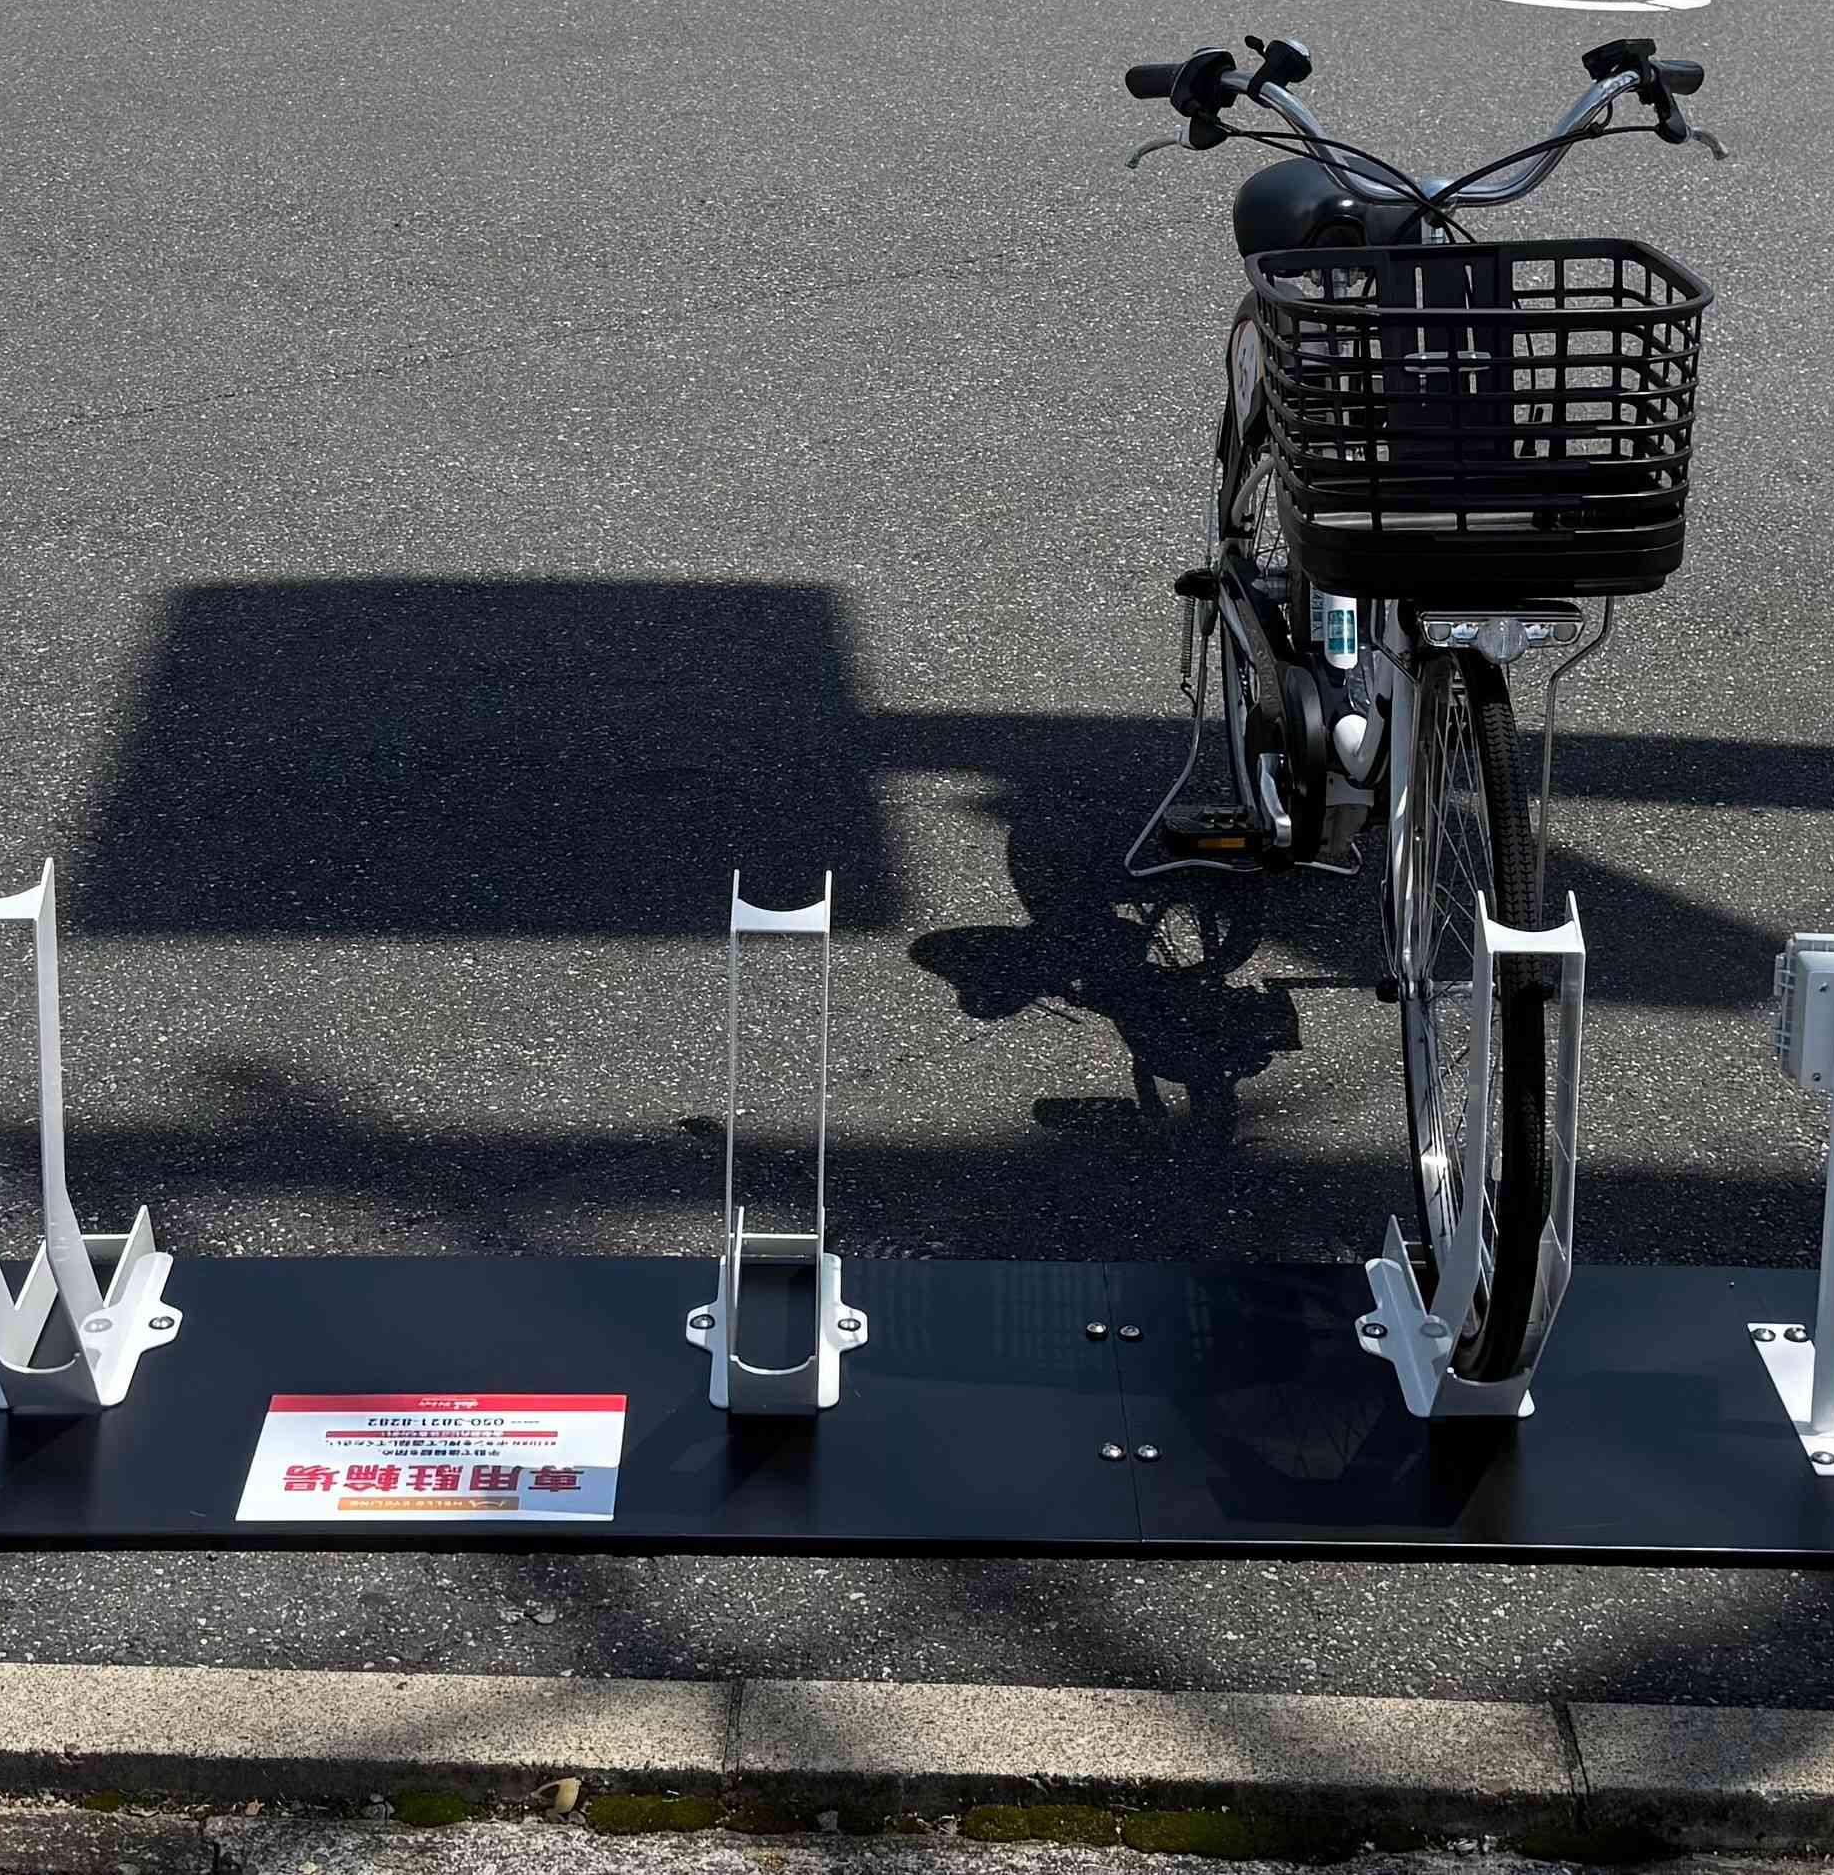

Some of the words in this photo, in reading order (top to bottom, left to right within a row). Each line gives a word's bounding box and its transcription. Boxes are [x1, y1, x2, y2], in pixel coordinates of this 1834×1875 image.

[282, 1464, 585, 1492] 専用駐輪場
